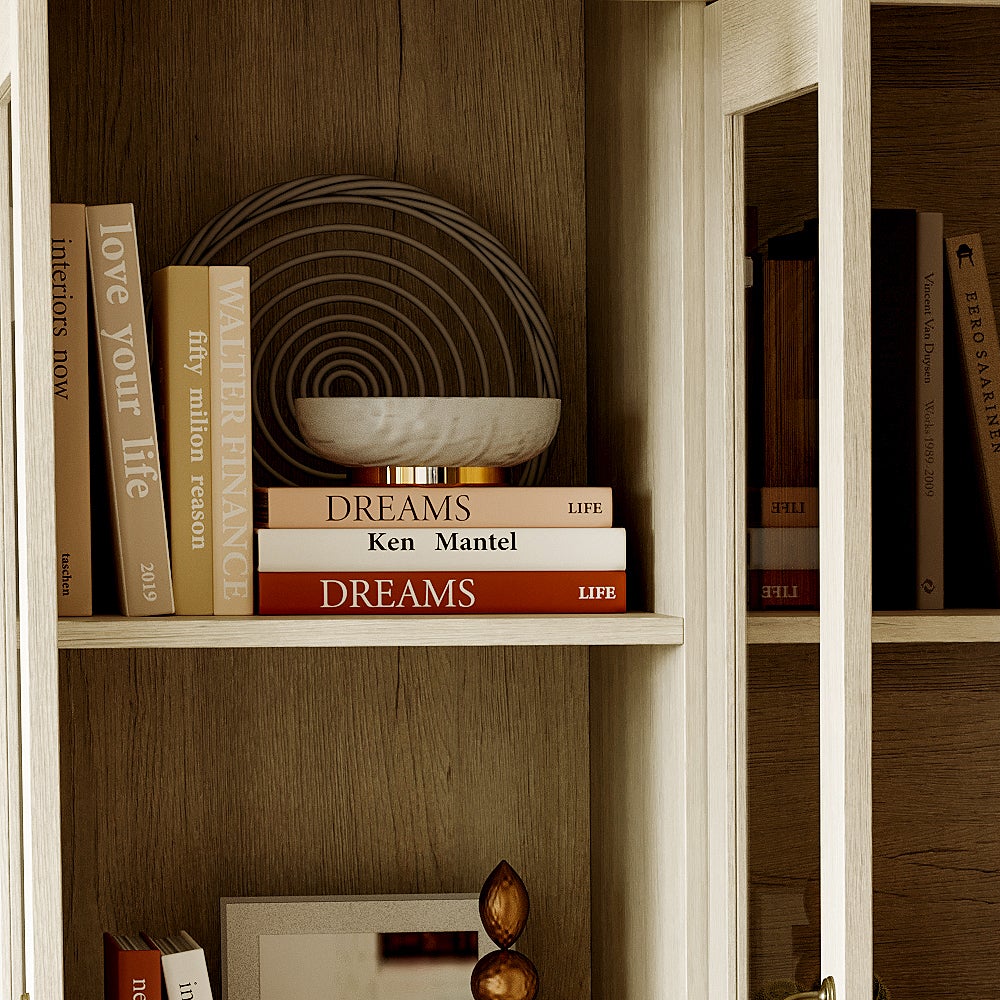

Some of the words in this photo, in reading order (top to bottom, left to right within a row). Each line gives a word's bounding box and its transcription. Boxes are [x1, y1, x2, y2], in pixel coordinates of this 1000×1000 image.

[100, 222, 133, 305] love
[51, 238, 73, 337] interiors
[924, 272, 935, 315] Vincent
[924, 319, 935, 340] Van
[965, 291, 985, 343] EERO
[101, 323, 141, 416] your
[184, 330, 208, 376] fifty
[217, 277, 247, 426] WALTER
[923, 343, 935, 384] Duysen
[53, 349, 69, 400] now
[189, 388, 208, 464] milion
[924, 400, 935, 435] Works
[122, 436, 158, 499] life
[190, 475, 205, 550] reason
[221, 434, 249, 600] FINANCE
[325, 494, 471, 522] DREAMS
[568, 502, 603, 514] LIFE
[367, 532, 416, 551] Ken
[435, 531, 518, 552] Mantel
[62, 553, 72, 596] taschen
[140, 562, 158, 601] 2019
[320, 578, 476, 609] DREAMS
[578, 586, 617, 600] LIFE
